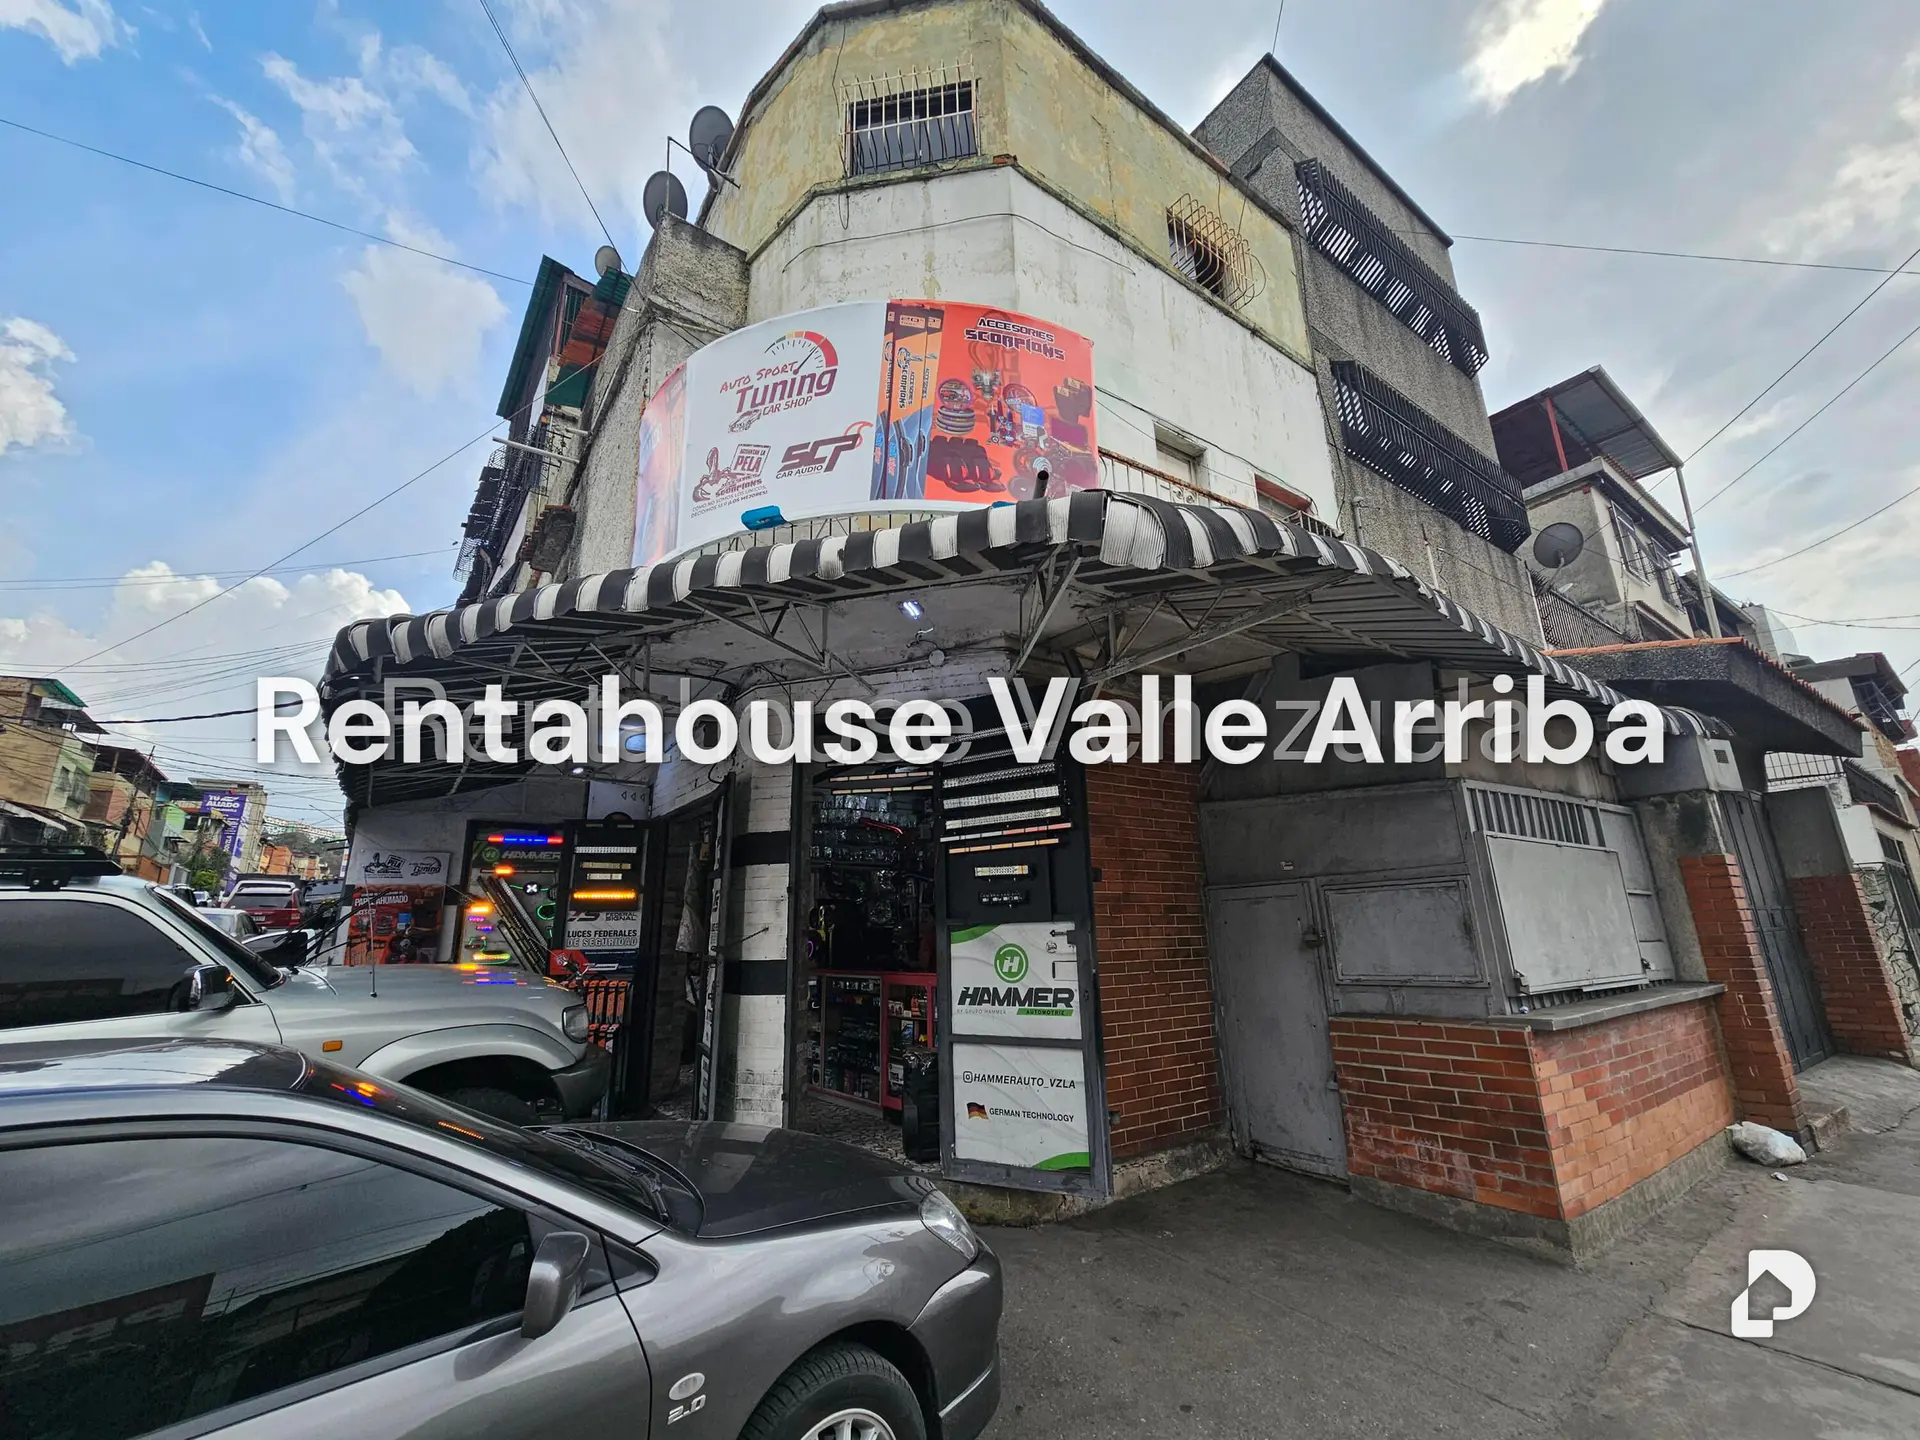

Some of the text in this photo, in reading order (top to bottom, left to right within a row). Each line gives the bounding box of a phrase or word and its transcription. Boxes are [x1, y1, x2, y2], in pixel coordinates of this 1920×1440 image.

[978, 318, 1054, 342] ACCESORIES
[965, 329, 1065, 360] SCORPIONS
[719, 361, 798, 394] AUTO SPORT
[736, 368, 838, 414] Tuning
[762, 395, 813, 416] CAR SHOP
[733, 455, 762, 473] PELA
[775, 471, 793, 480] CAR
[794, 464, 823, 477] AUDIO
[502, 851, 561, 860] HAMMER
[566, 937, 638, 948] DE SEGURIDAD
[567, 929, 637, 938] LUCES FEDERALES
[957, 986, 1075, 1008] HAMMER
[989, 1107, 1075, 1123] GERMAN TECHNOLOGY
[667, 1394, 706, 1425] 2.0
